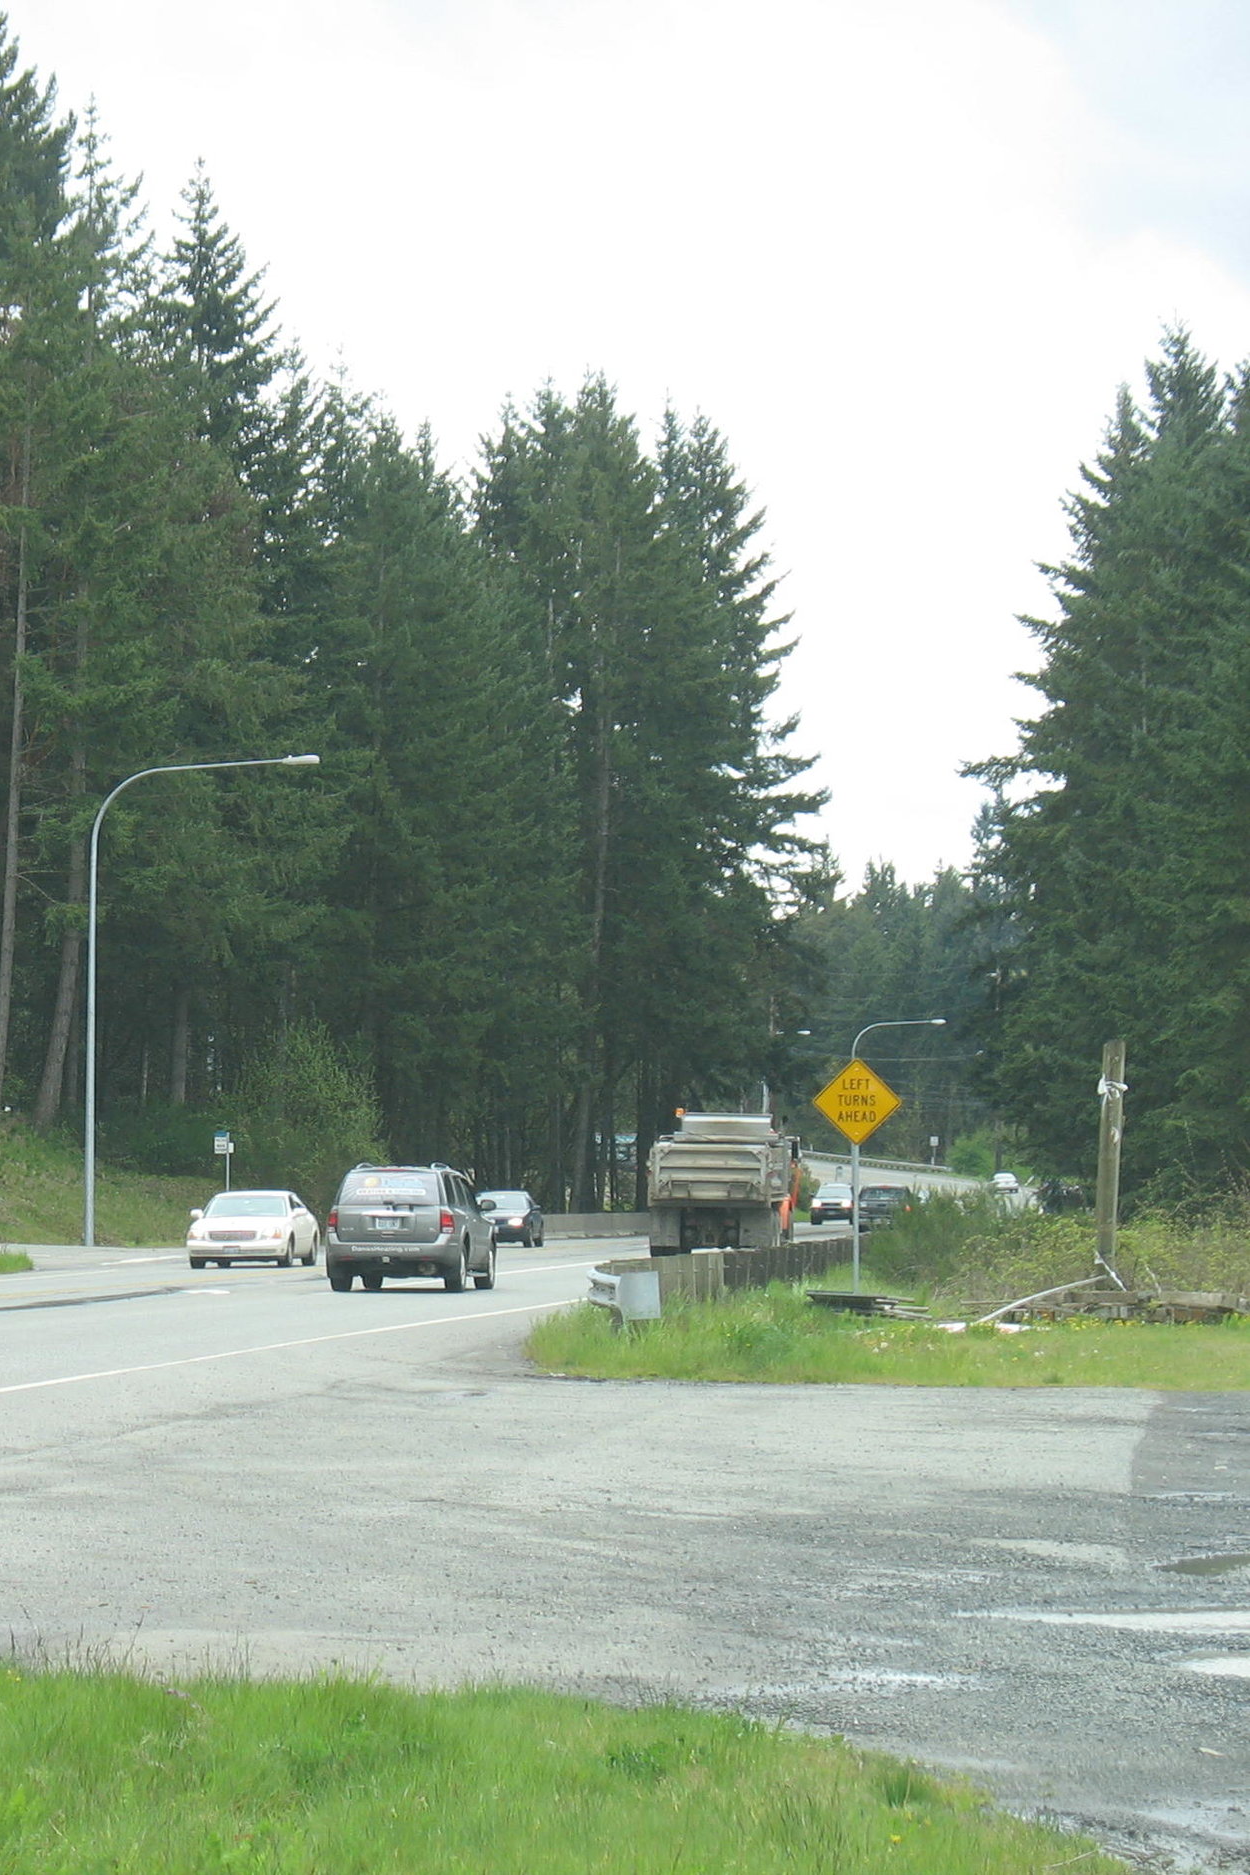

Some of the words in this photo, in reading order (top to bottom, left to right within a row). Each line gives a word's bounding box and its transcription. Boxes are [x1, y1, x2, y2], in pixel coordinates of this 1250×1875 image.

[842, 1079, 870, 1090] LEFT
[838, 1095, 876, 1106] TURNS
[837, 1111, 877, 1122] AHEAD
